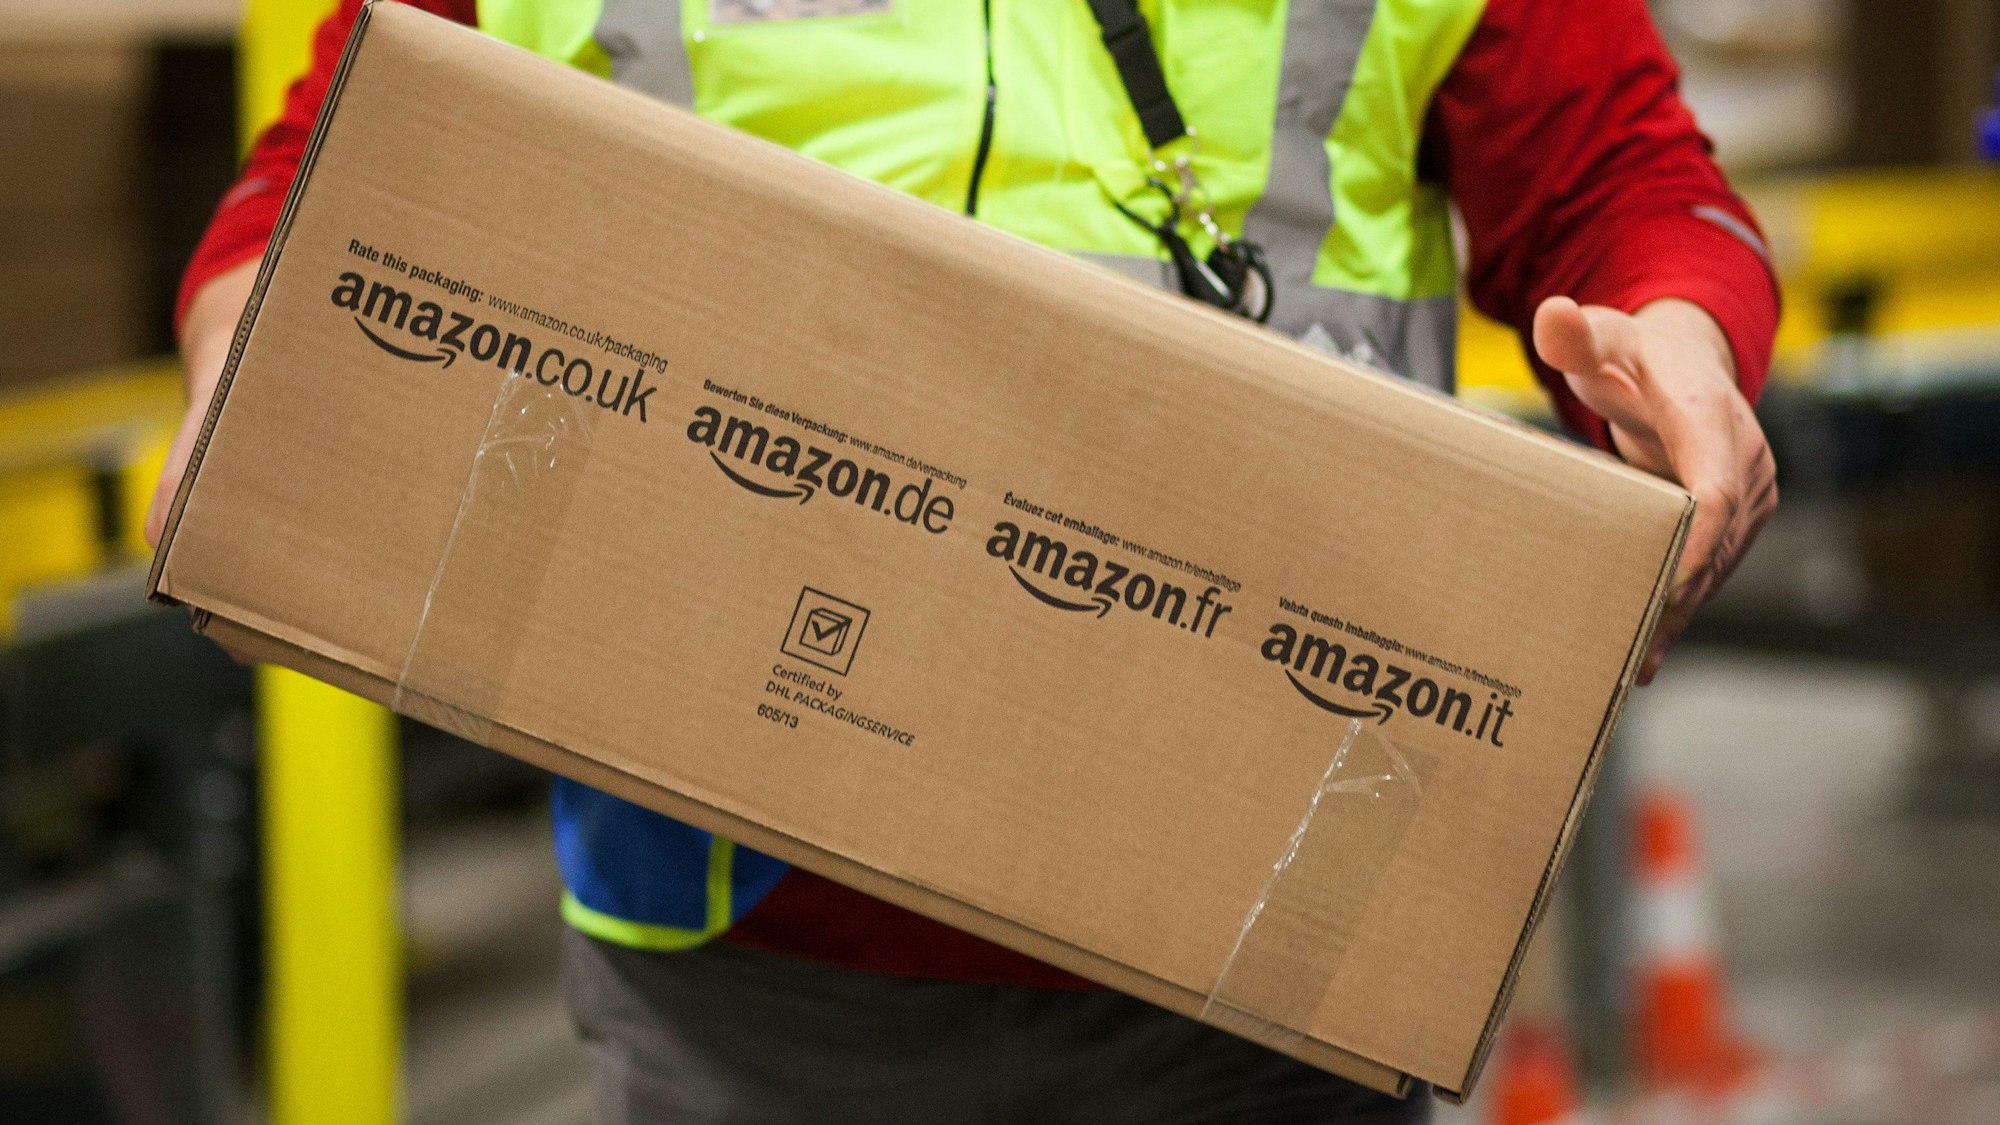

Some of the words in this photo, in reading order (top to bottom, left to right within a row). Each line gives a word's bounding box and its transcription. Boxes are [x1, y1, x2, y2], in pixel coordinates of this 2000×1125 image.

[331, 271, 657, 423] amazon.co.uk
[348, 239, 379, 263] Rate
[382, 252, 408, 274] this
[408, 264, 484, 303] packaging:
[488, 294, 668, 374] www.amazon.co.uk/packaging
[686, 405, 955, 534] amazon.de
[703, 378, 748, 405] Bewerten
[749, 396, 764, 411] Sie
[765, 400, 790, 421] diese
[791, 412, 849, 443] Verpackung:
[849, 435, 967, 490] www.amazon.de/verpackung
[986, 521, 1232, 638] amazon.fr
[1003, 491, 1044, 518] Évaluez
[1045, 510, 1063, 525] cet
[1063, 516, 1120, 546] emballage:
[1122, 539, 1241, 592] www.amazon.fr/emballage
[1278, 596, 1309, 618] Valuta
[1311, 611, 1343, 631] questo
[757, 703, 799, 729] 605/13
[766, 680, 791, 700] DHL
[793, 691, 916, 747] PACKAGINGSERVICE
[772, 664, 826, 692] Certified
[827, 683, 842, 700] by
[1260, 623, 1514, 748] amazon.it
